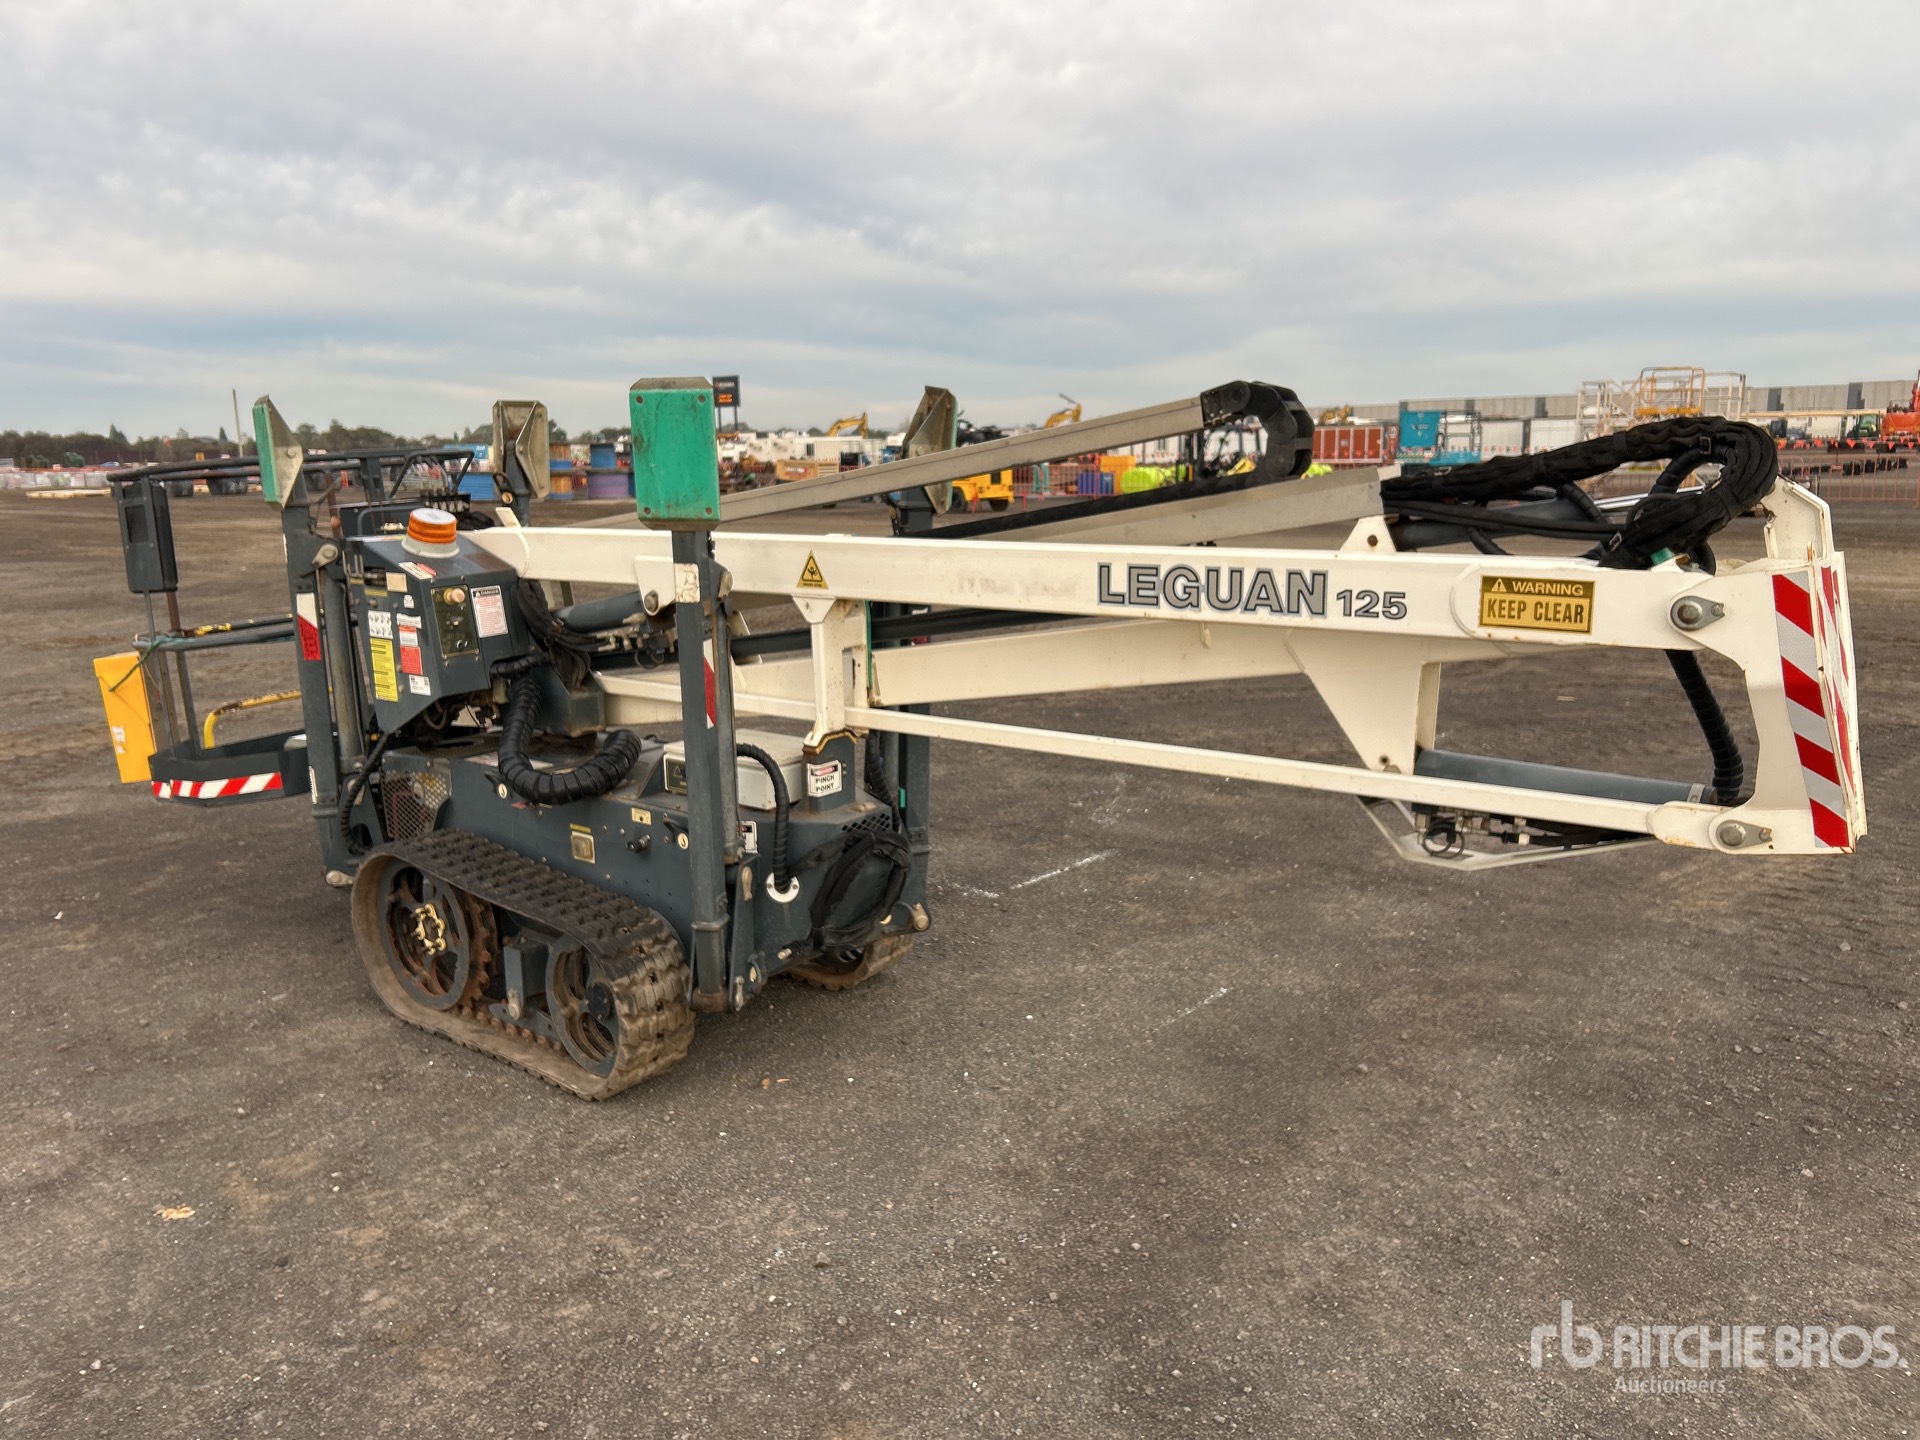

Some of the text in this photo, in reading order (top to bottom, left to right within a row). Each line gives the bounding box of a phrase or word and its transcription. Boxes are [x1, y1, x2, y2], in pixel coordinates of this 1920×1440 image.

[1098, 562, 1329, 617] LEGUAN
[1336, 588, 1407, 620] 125
[1512, 580, 1584, 597] WARNING
[1487, 598, 1585, 624] KEEP CLEAR
[815, 775, 834, 784] PINCH
[815, 783, 834, 792] POINT
